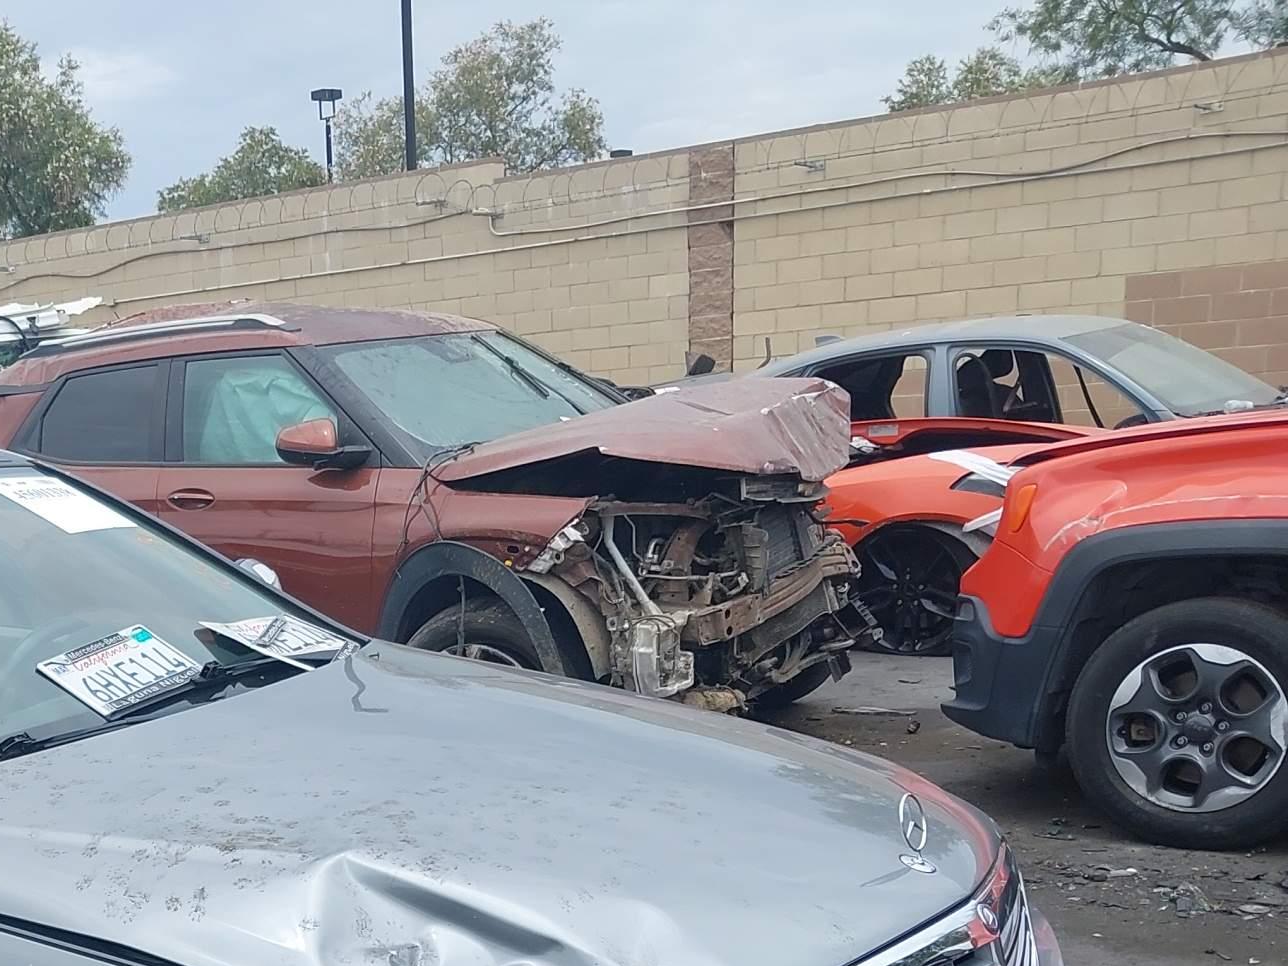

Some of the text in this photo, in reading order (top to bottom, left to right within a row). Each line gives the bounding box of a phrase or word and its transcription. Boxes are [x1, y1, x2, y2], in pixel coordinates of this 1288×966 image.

[67, 634, 122, 660] Mercedes-Benz
[73, 643, 129, 672] California
[82, 648, 187, 702] 6HXE114
[111, 664, 200, 709] Laguna Niguel
